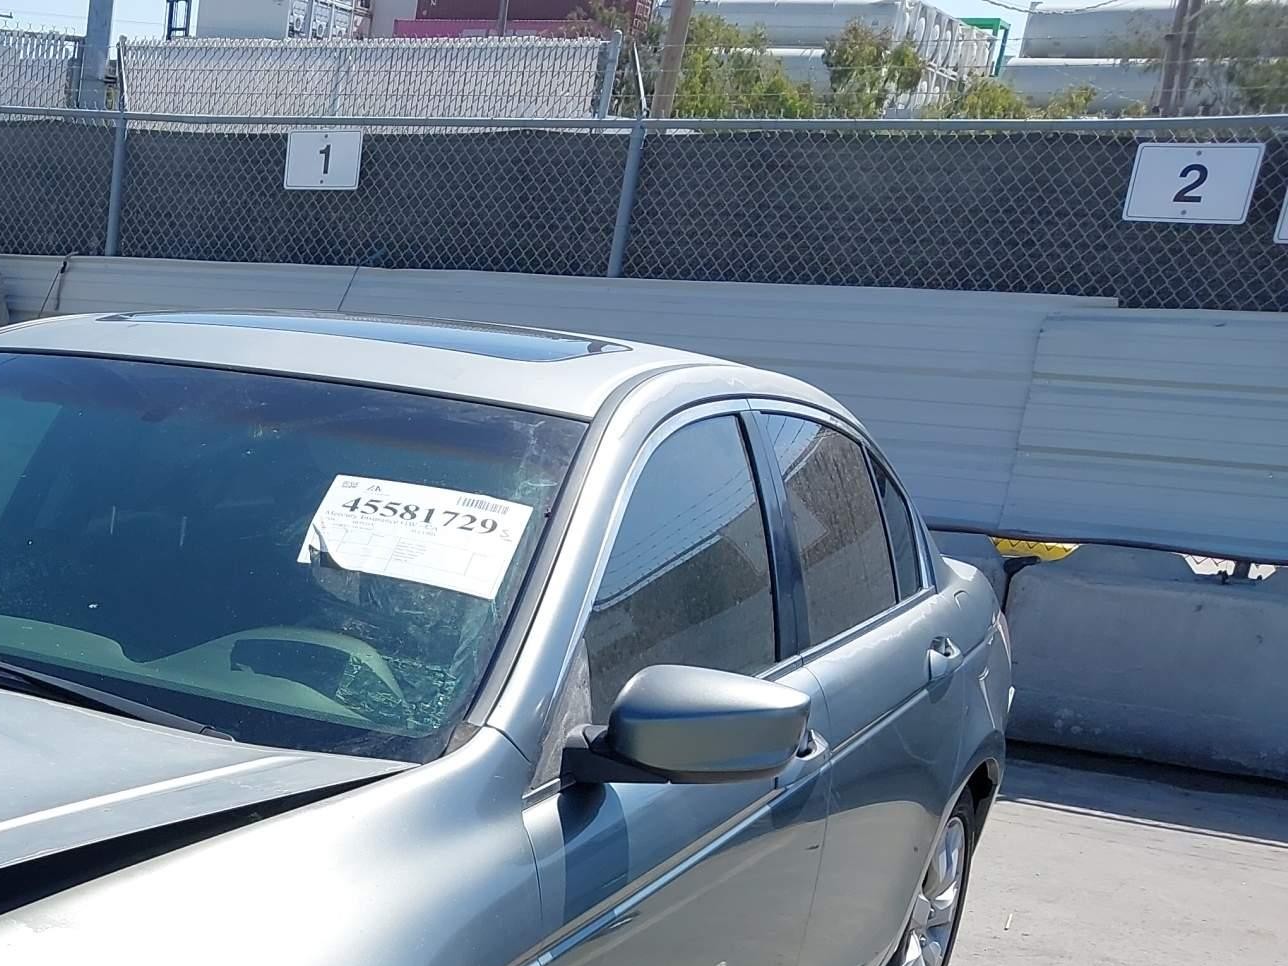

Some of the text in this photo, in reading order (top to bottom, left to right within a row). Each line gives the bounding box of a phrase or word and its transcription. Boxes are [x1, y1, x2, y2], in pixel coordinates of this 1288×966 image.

[319, 144, 331, 175] 1
[1172, 163, 1209, 203] 2
[341, 497, 499, 534] 45581729
